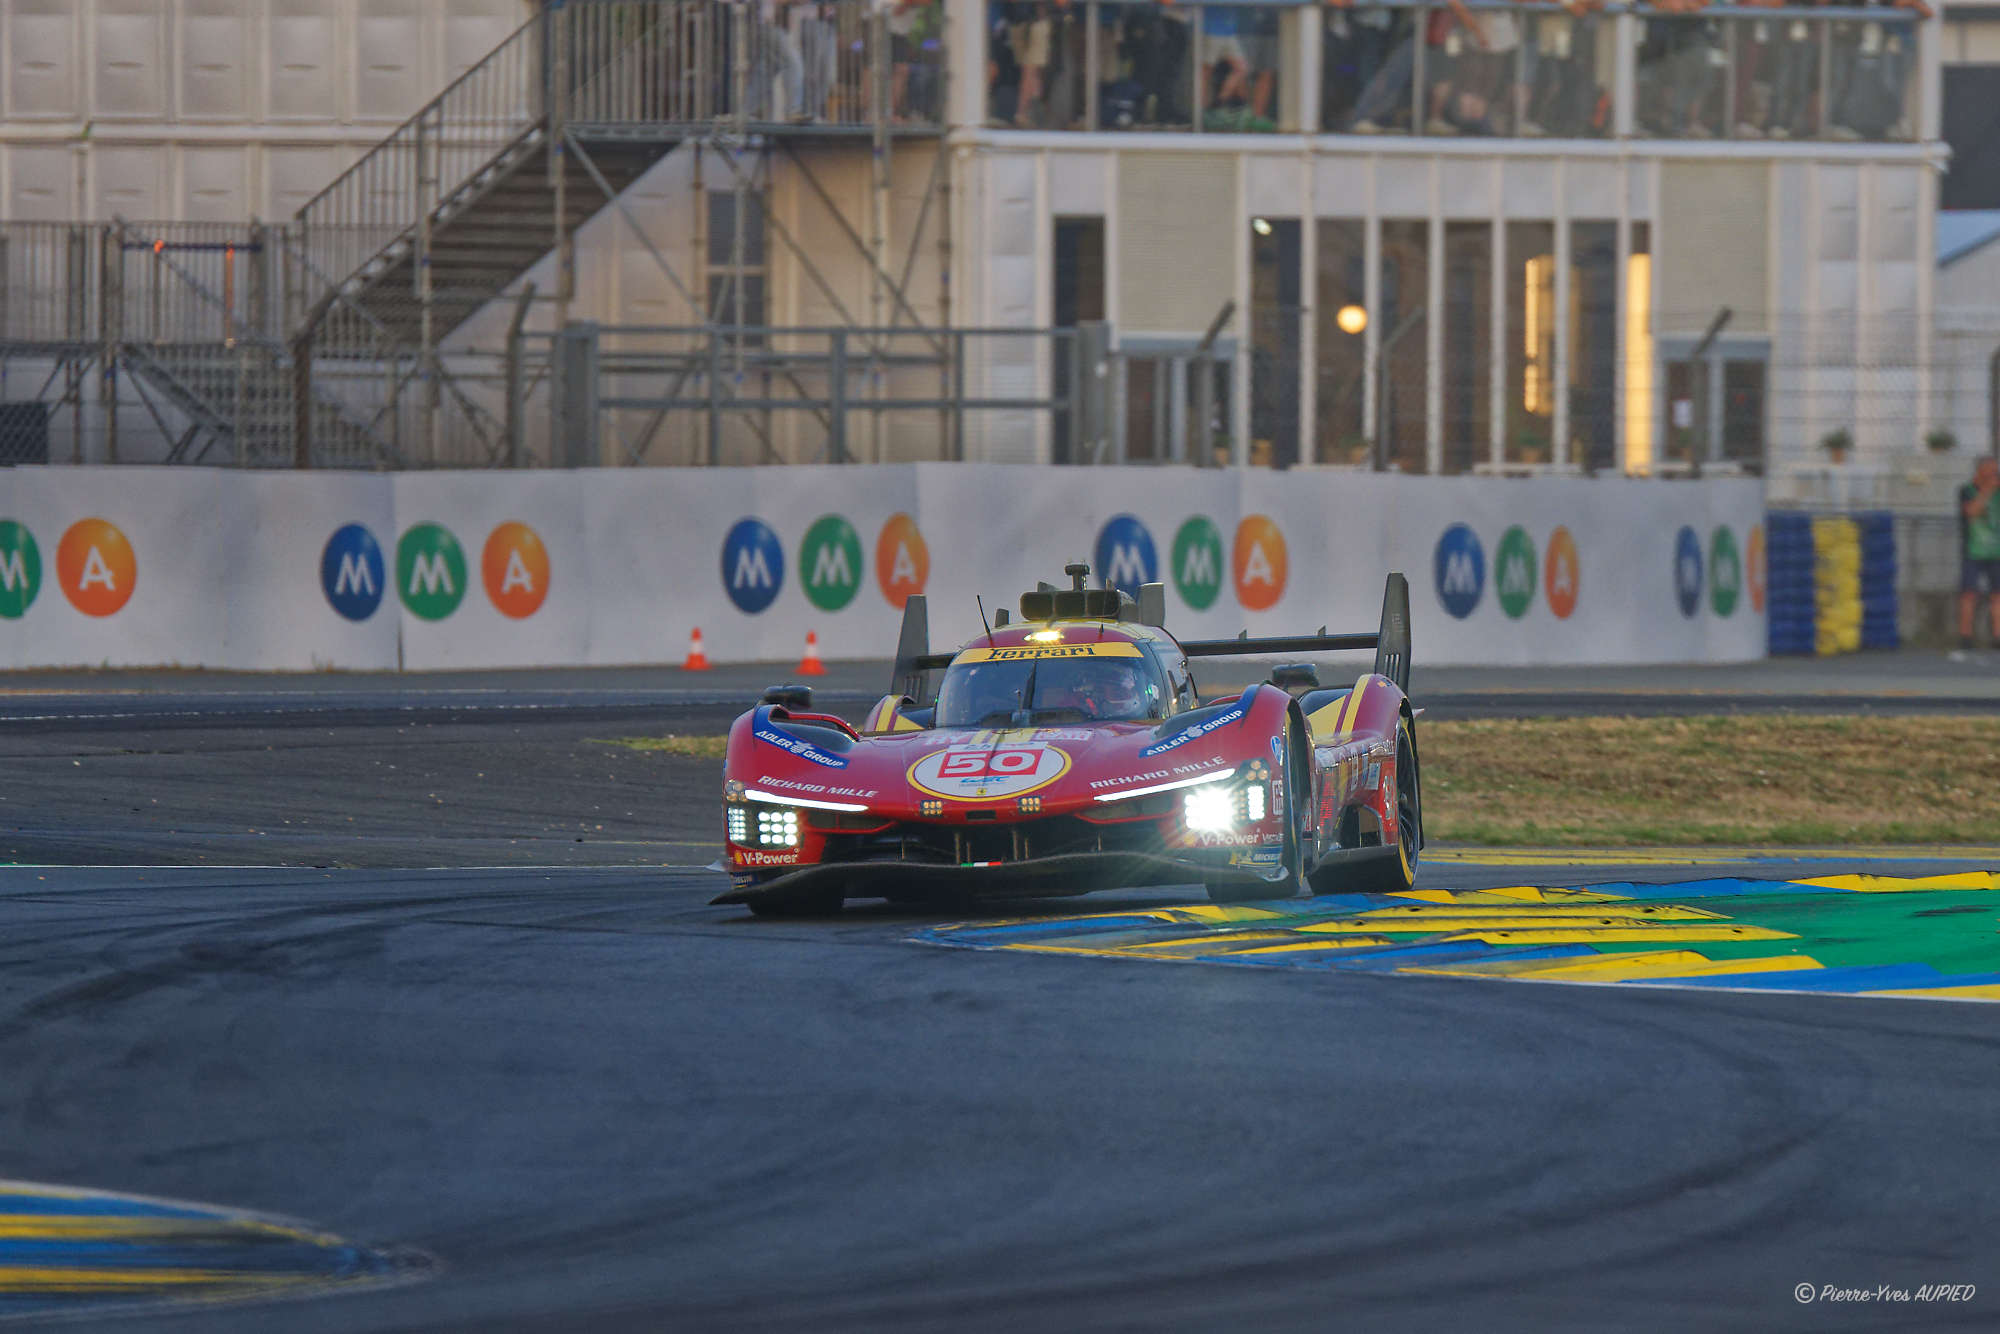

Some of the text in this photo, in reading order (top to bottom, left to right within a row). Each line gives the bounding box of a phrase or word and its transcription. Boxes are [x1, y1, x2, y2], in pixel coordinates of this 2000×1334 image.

[983, 643, 1097, 661] Ferrari
[1146, 709, 1243, 756] ADLER GROUP
[755, 730, 844, 767] ADLER GROUP
[943, 751, 1036, 775] 50
[1089, 755, 1227, 789] RICHARD MILLE
[757, 775, 879, 798] RICHARD MILLE
[743, 852, 798, 865] V-Power
